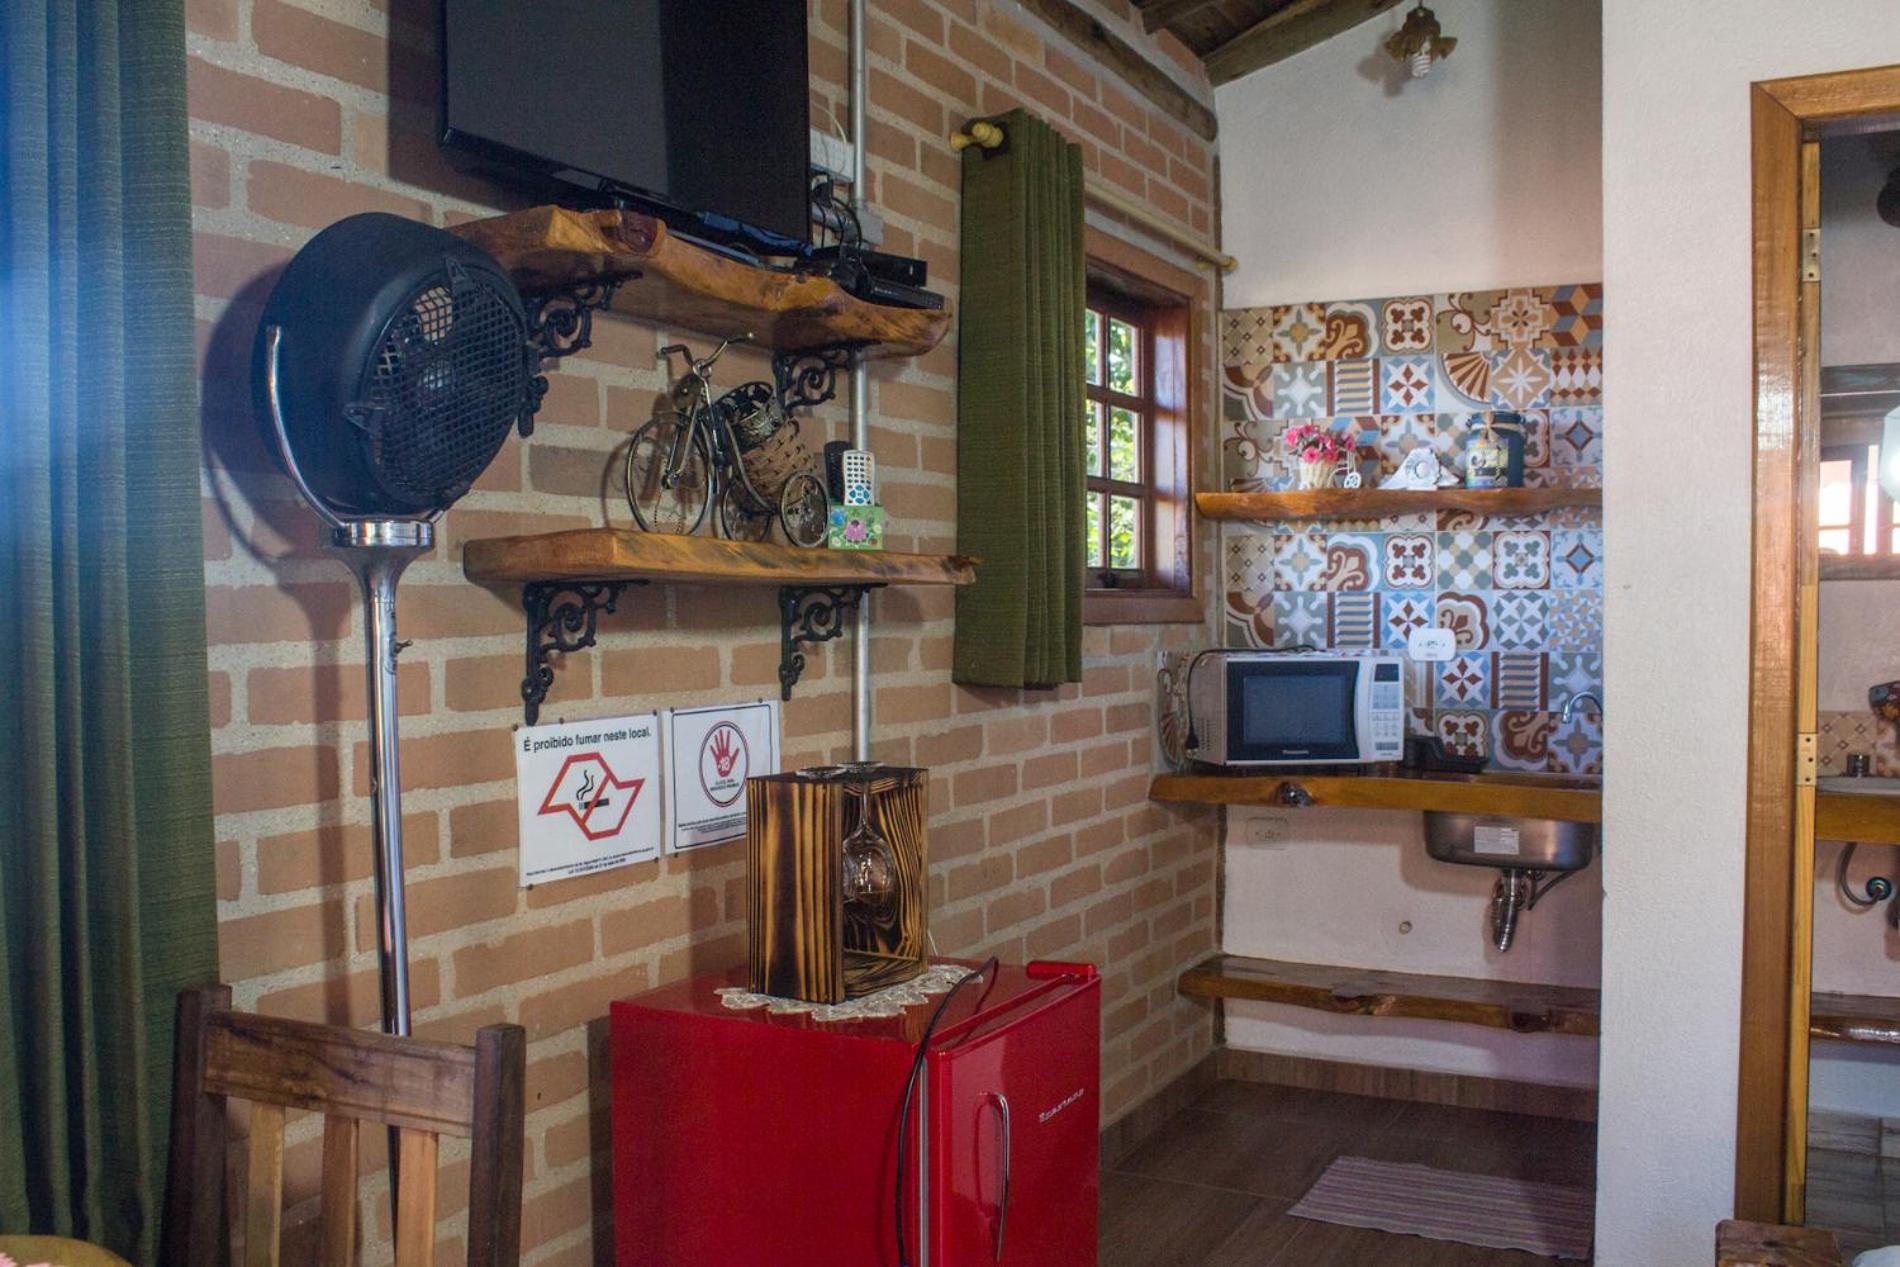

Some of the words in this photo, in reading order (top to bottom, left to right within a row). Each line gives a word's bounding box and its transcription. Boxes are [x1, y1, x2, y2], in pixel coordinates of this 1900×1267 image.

[524, 736, 531, 752] É
[534, 736, 574, 753] proibido
[575, 734, 602, 745] fumar
[603, 730, 627, 742] neste
[629, 726, 651, 739] local.
